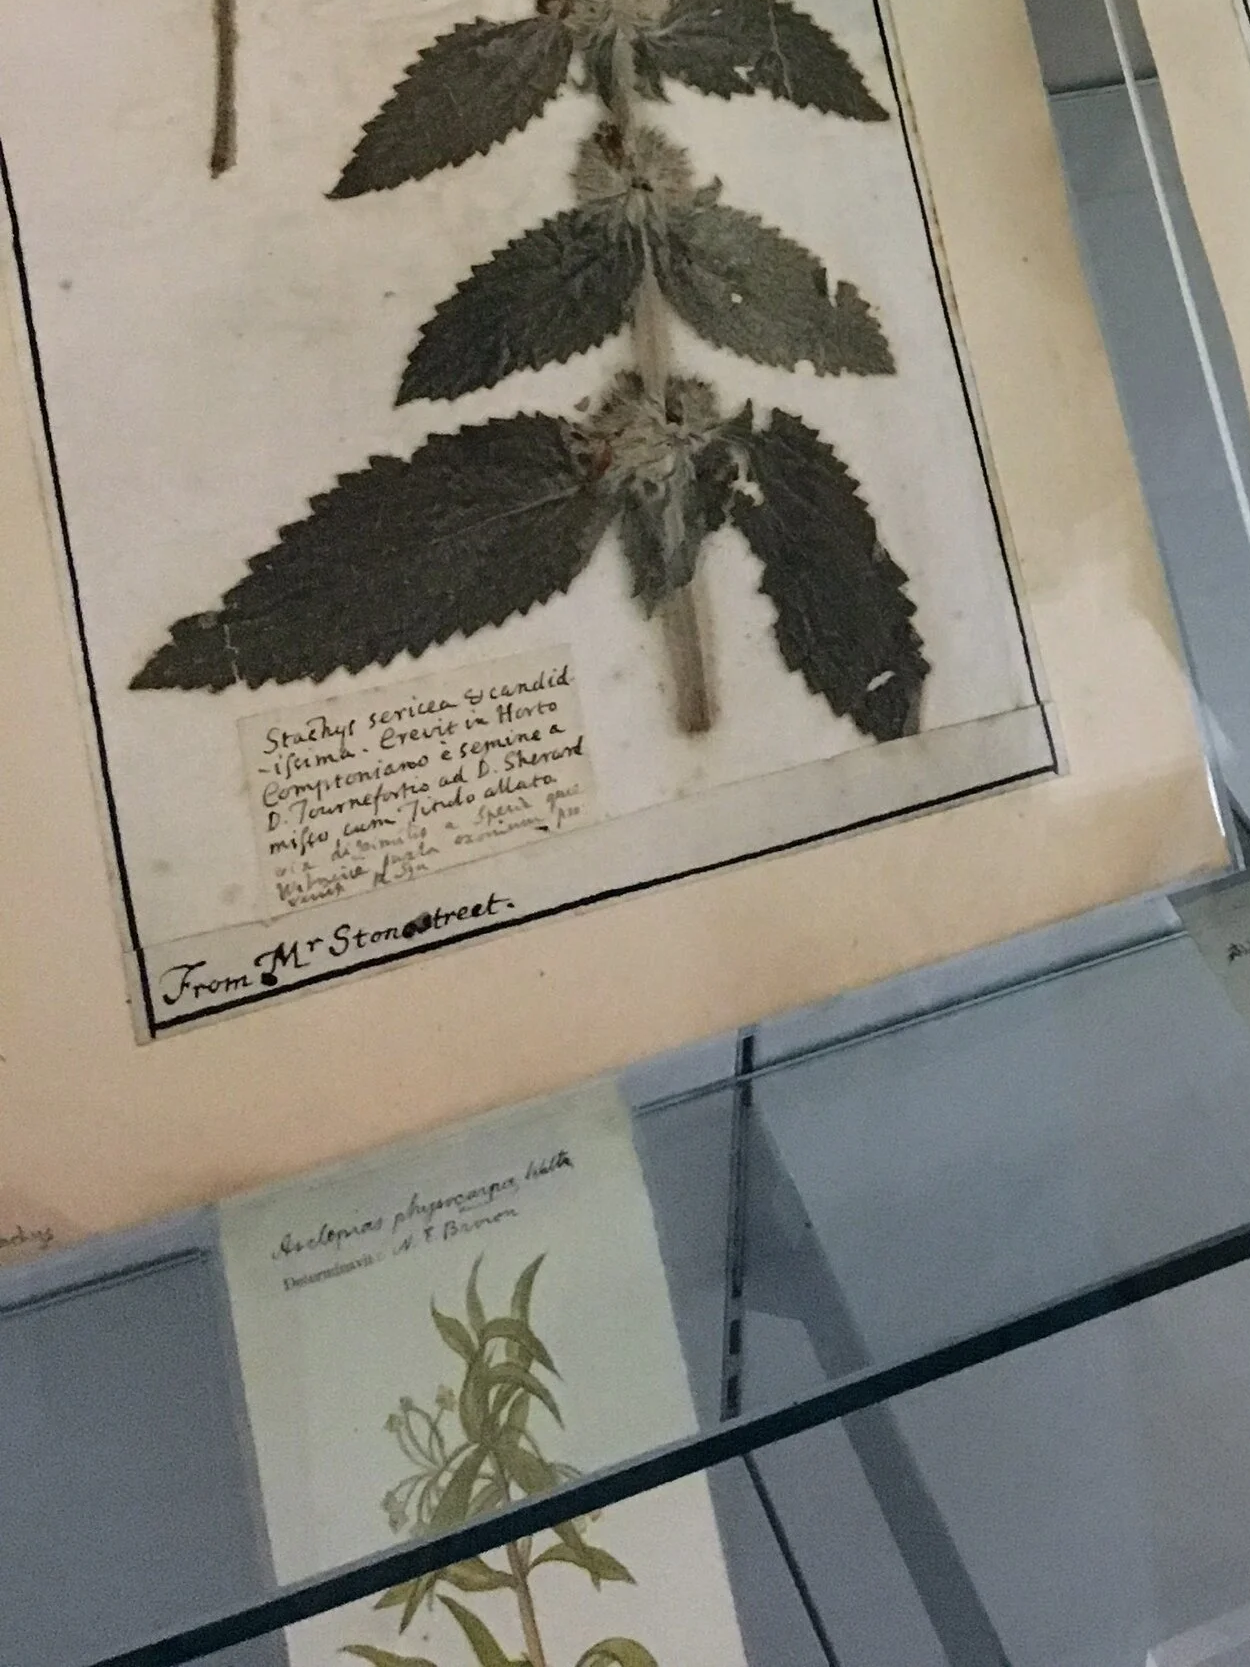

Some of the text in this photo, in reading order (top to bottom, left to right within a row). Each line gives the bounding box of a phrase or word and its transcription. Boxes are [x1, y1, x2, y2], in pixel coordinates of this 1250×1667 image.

[368, 694, 458, 730] sericea
[465, 709, 489, 730] in
[496, 701, 557, 725] Horto
[459, 729, 542, 759] semine
[549, 723, 566, 735] a
[439, 765, 468, 788] ad
[504, 734, 583, 772] Sherard
[159, 960, 253, 1005] From
